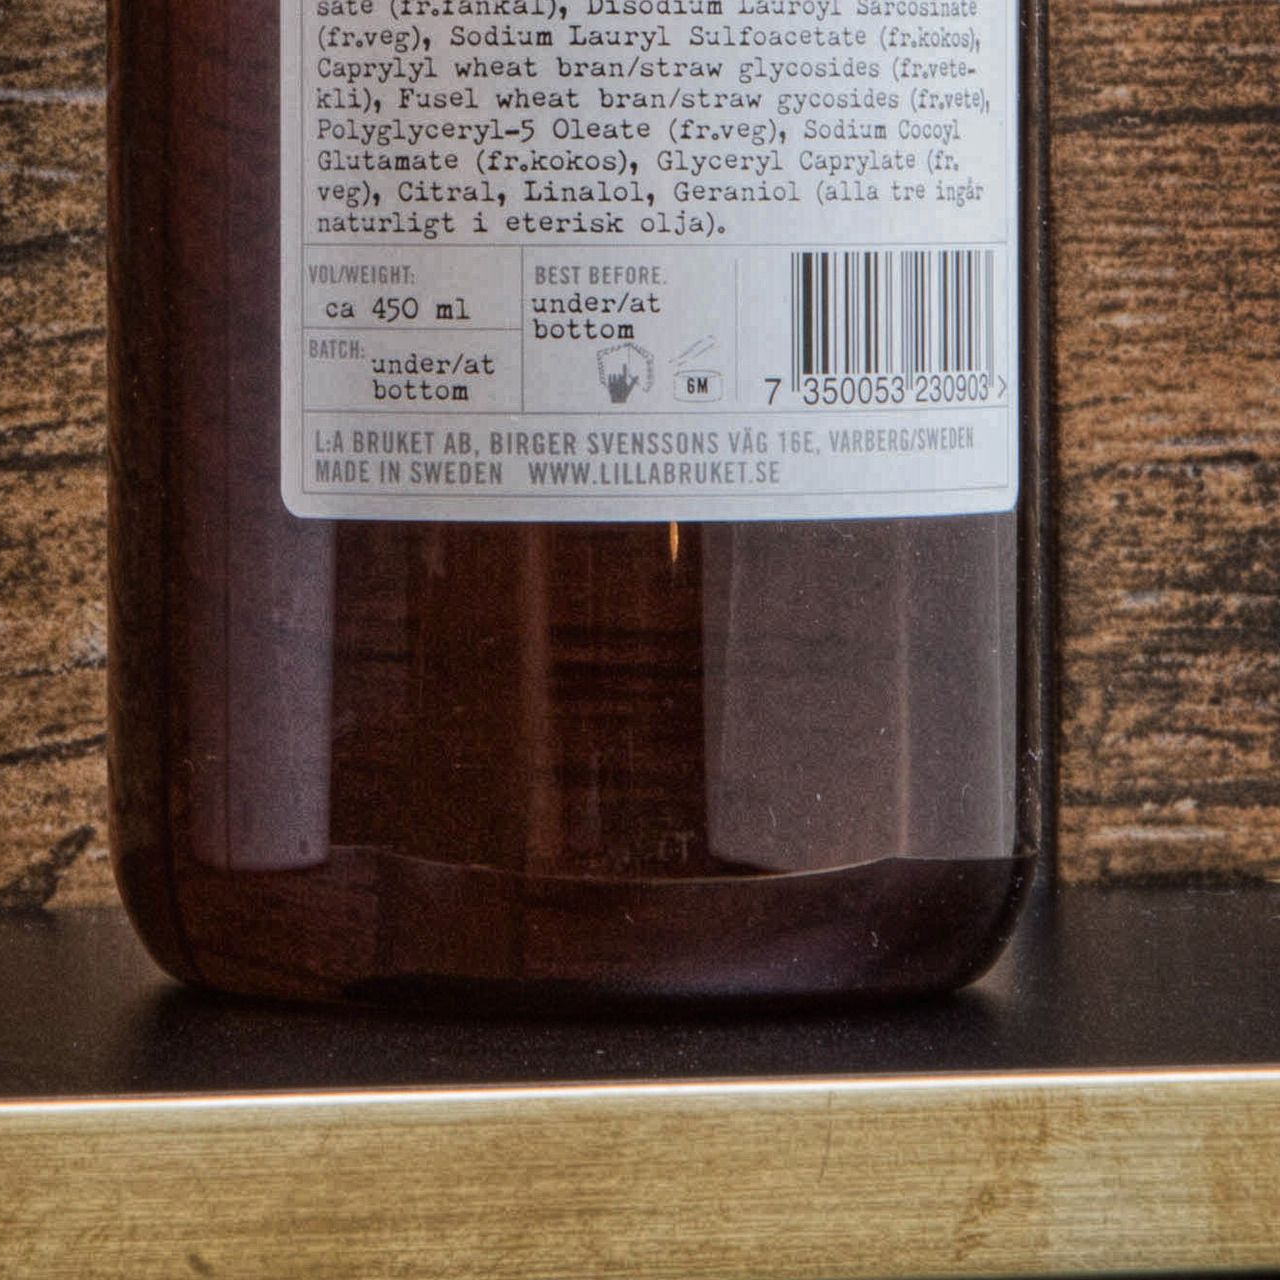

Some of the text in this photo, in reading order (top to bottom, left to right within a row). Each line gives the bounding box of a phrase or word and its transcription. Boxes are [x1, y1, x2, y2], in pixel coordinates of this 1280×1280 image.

[318, 25, 980, 53] (fr.veg), Sodium Lauryl Sulfoacetate (fr.kokos),
[317, 57, 976, 83] Caprylyl wheat bran/straw glycosides (fr.vete-
[316, 87, 990, 114] kli), Fusel wheat bran/straw gycosides (fr.vete),
[317, 119, 961, 145] Polyglyceryl-5 Oleate (fr.veg), Sodium Cocoyl
[317, 149, 959, 176] Glutamate (fr.kokos), Glyceryl Caprylate (fr.
[317, 178, 984, 208] veg), Citral, Linalol, Geraniol (alla tre ingår
[317, 212, 725, 239] naturligt i eterisk olja).
[307, 265, 415, 285] VOL/WEIGHT:
[535, 266, 581, 285] BEST
[326, 297, 471, 322] ca 450 ml
[531, 292, 661, 313] under/at
[532, 319, 635, 340] bottom
[309, 340, 365, 359] BATCH:
[371, 354, 495, 375] under/at
[373, 380, 469, 401] bottom
[687, 377, 708, 394] 6M
[764, 378, 782, 405] 7
[803, 377, 904, 405] 350053
[353, 431, 434, 454] BRUKET
[443, 432, 480, 458] AB,
[491, 432, 577, 456] BIRGER
[588, 432, 720, 455] SVENSSONS
[729, 428, 767, 454] VÄG
[780, 430, 821, 455] 16E,
[830, 426, 974, 453] VARBERG/SWEDEN
[315, 460, 781, 485] MADE IN SWEDEN WWW.LILLABRUKET.SE
